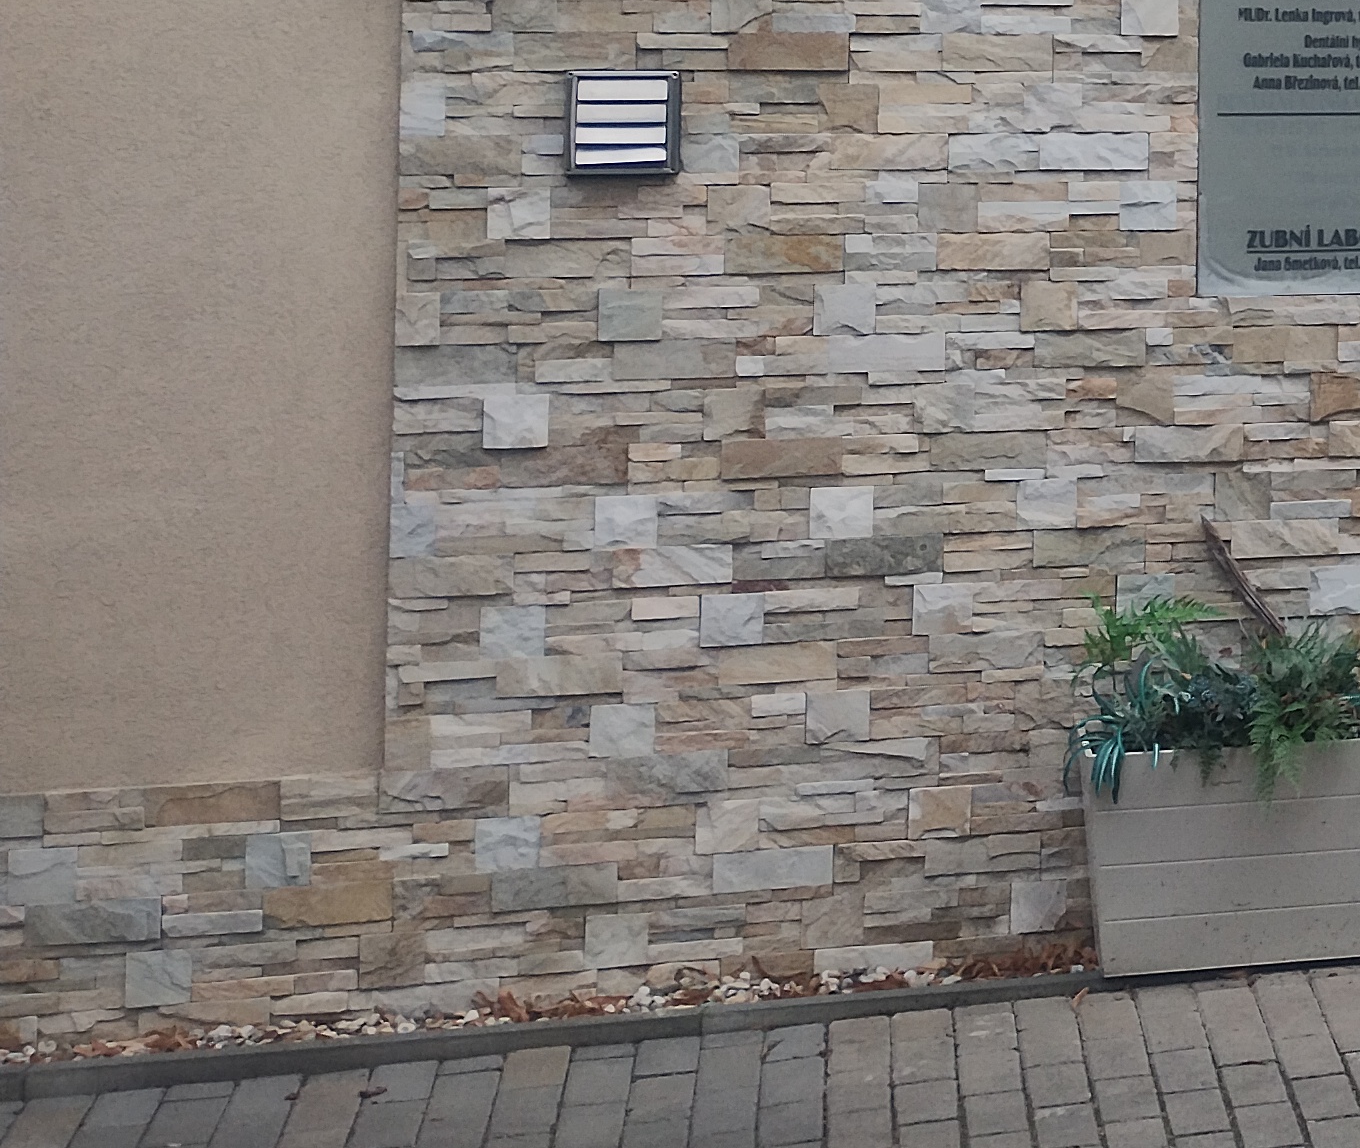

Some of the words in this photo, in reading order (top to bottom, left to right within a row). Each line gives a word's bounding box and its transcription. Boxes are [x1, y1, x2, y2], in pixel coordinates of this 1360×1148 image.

[1238, 7, 1272, 23] MUDr.
[1275, 7, 1309, 23] Lenka
[1243, 52, 1290, 68] Gabriela
[1253, 75, 1282, 90] Anna
[1246, 224, 1312, 249] ZUBNÍ
[1254, 256, 1282, 272] Jana
